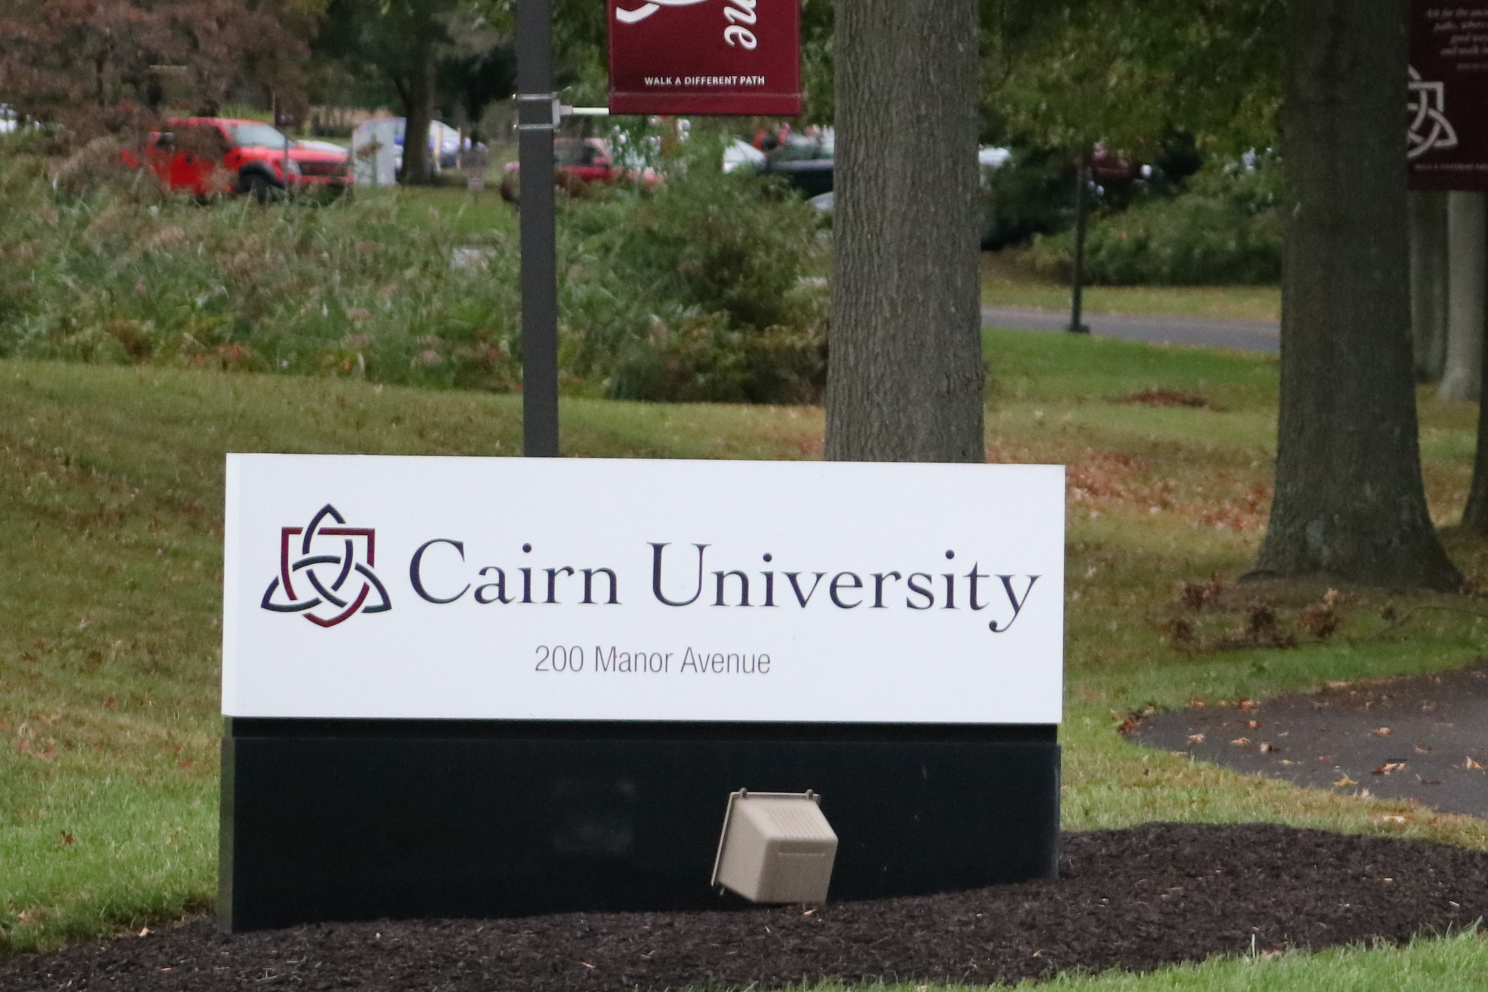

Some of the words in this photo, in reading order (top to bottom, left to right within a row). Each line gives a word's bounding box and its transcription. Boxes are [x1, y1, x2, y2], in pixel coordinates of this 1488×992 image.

[644, 76, 672, 86] WALK
[675, 76, 682, 85] A
[684, 75, 738, 85] DIFFERENT
[740, 75, 766, 85] PATH
[409, 537, 624, 605] Cairn
[646, 541, 1042, 634] University
[535, 645, 585, 673] 200
[595, 645, 674, 674] Manor
[680, 646, 771, 674] Avenue
